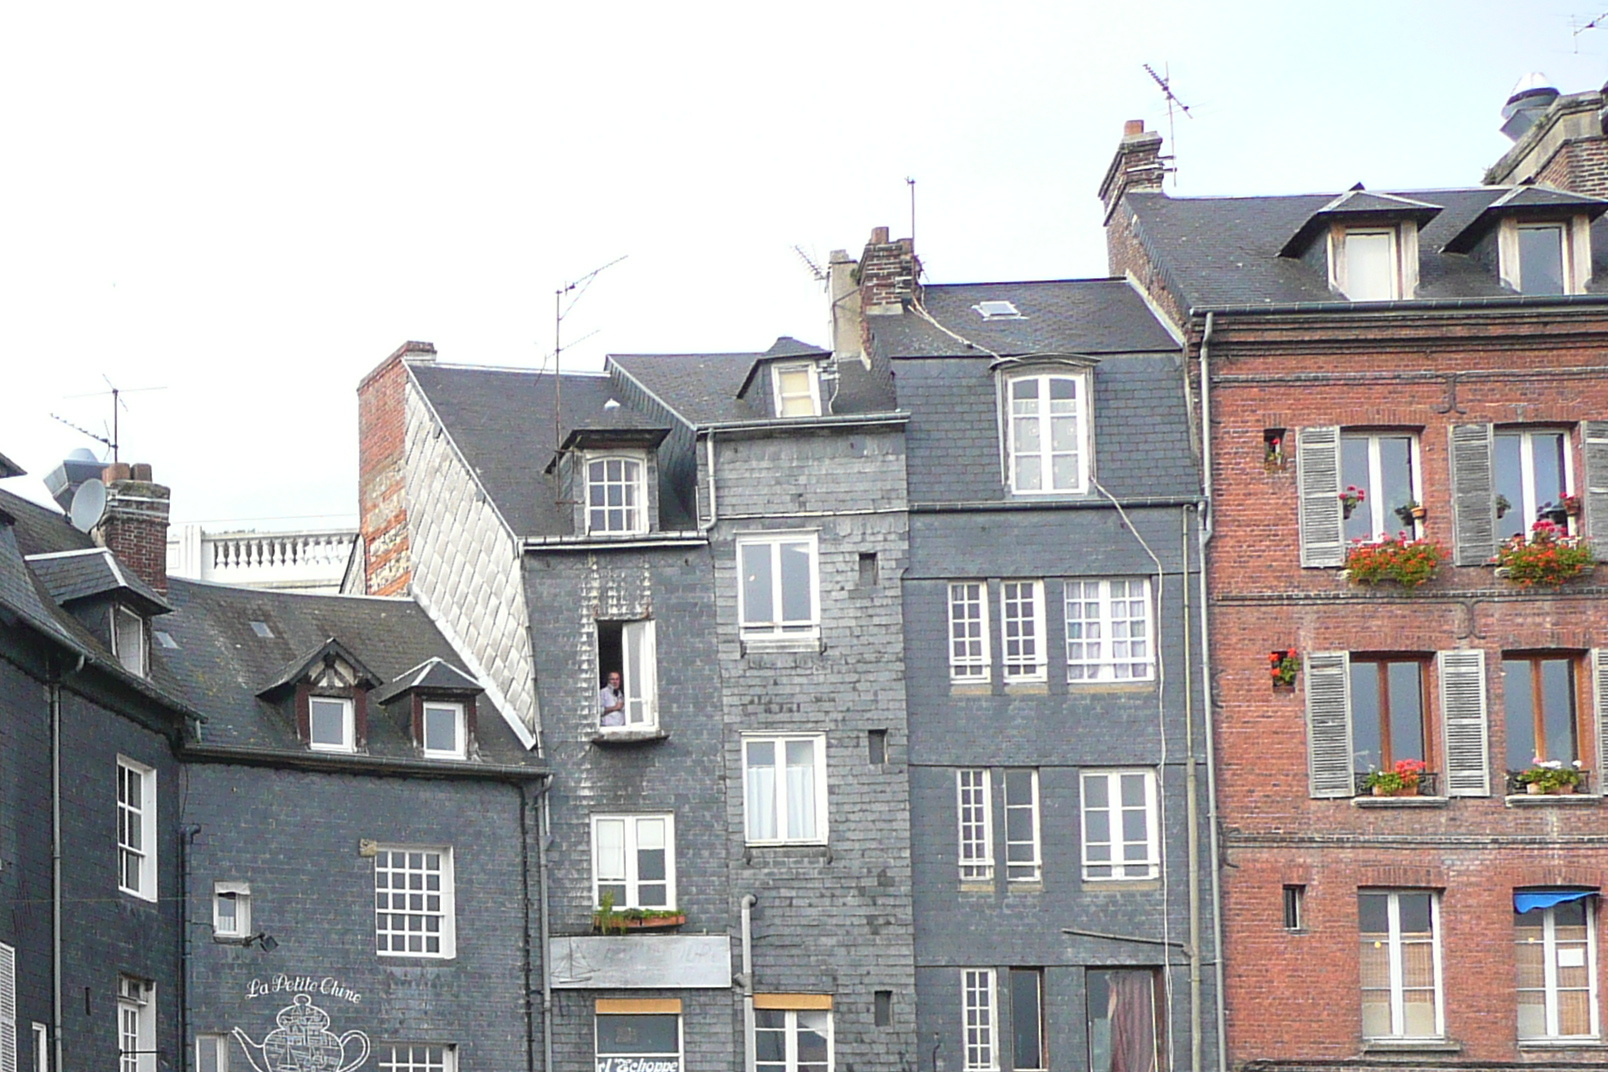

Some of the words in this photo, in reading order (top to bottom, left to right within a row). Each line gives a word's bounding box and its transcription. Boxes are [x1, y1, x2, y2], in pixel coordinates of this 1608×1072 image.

[245, 978, 269, 1000] La
[272, 973, 318, 993] Petite
[320, 976, 362, 1004] Chine
